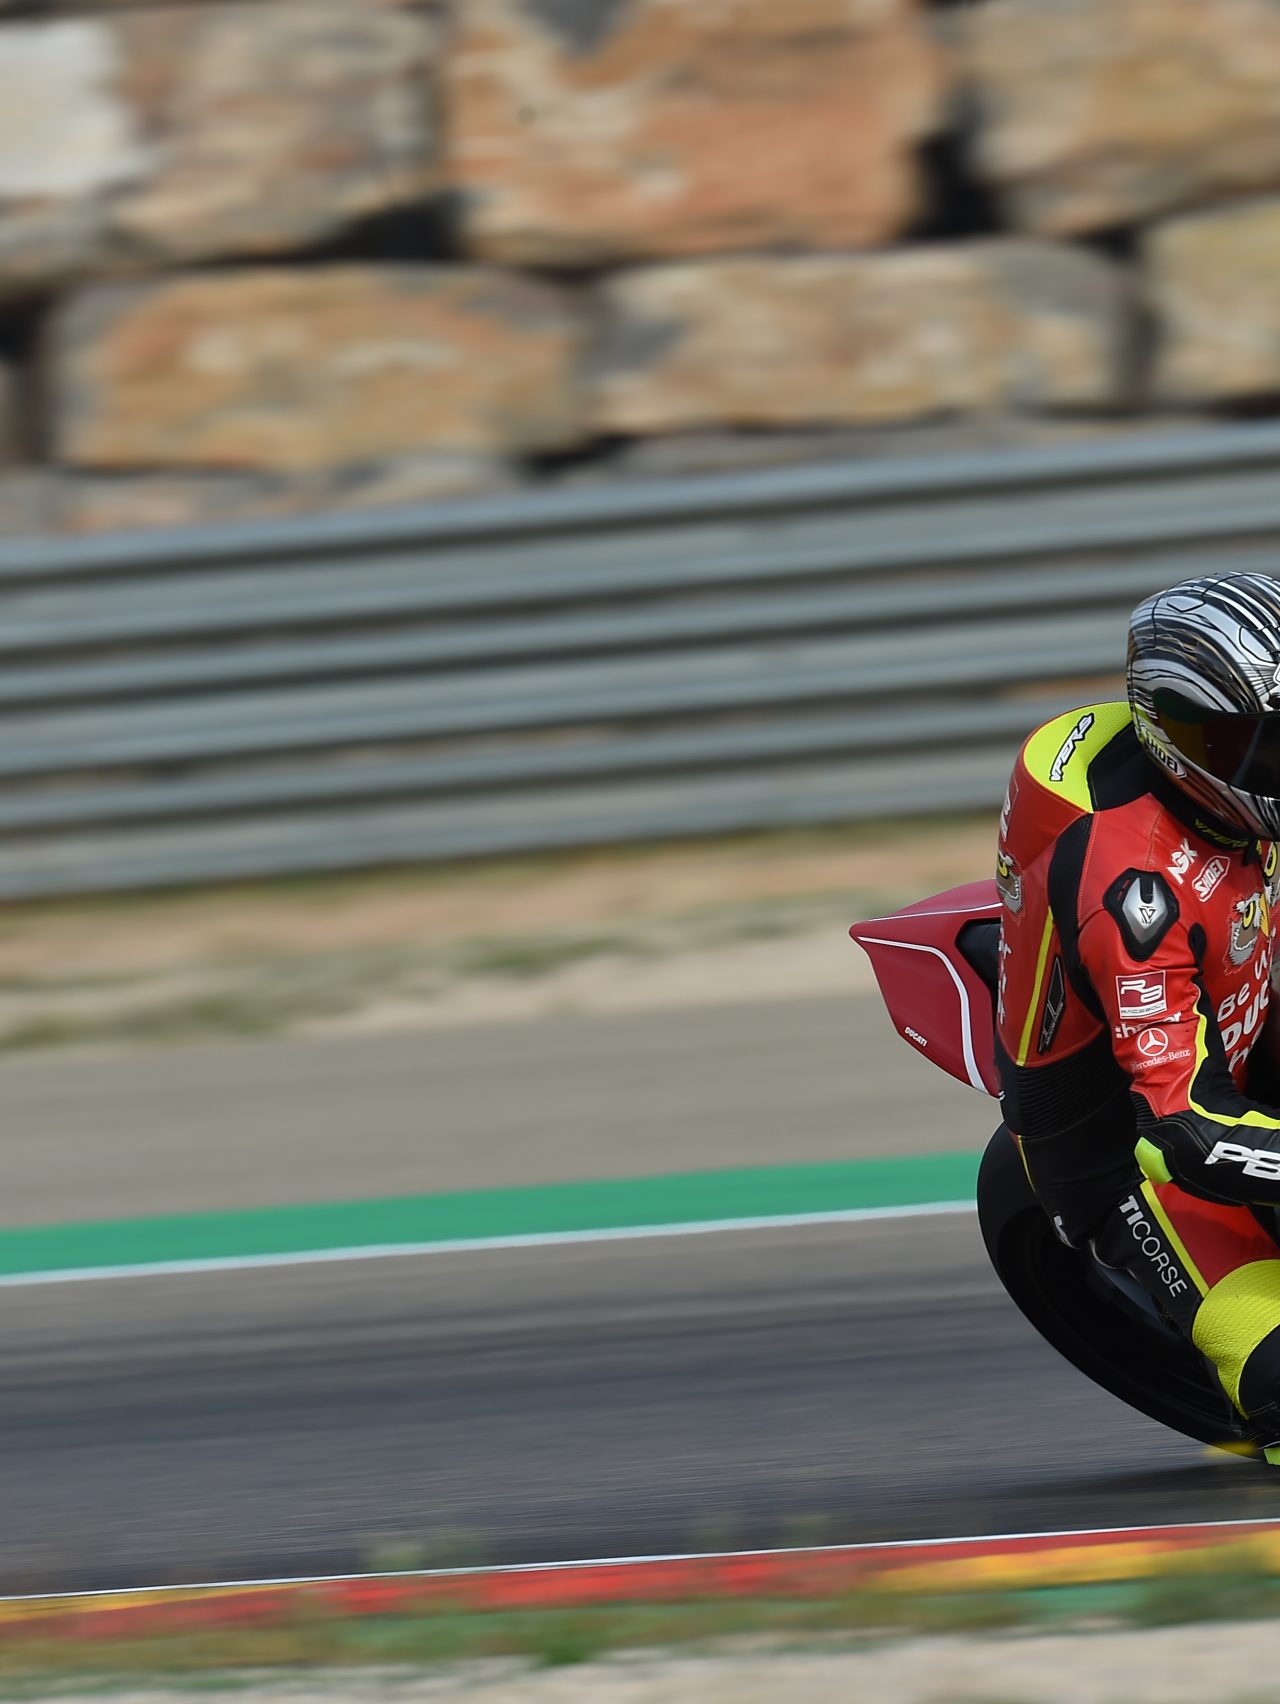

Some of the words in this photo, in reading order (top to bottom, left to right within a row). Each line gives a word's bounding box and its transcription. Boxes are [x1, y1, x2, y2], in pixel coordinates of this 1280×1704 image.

[1166, 837, 1198, 885] NGK
[1194, 859, 1225, 898] SHOEI
[904, 1026, 928, 1047] DUCATI
[1131, 1049, 1191, 1072] Mercedes-Benz
